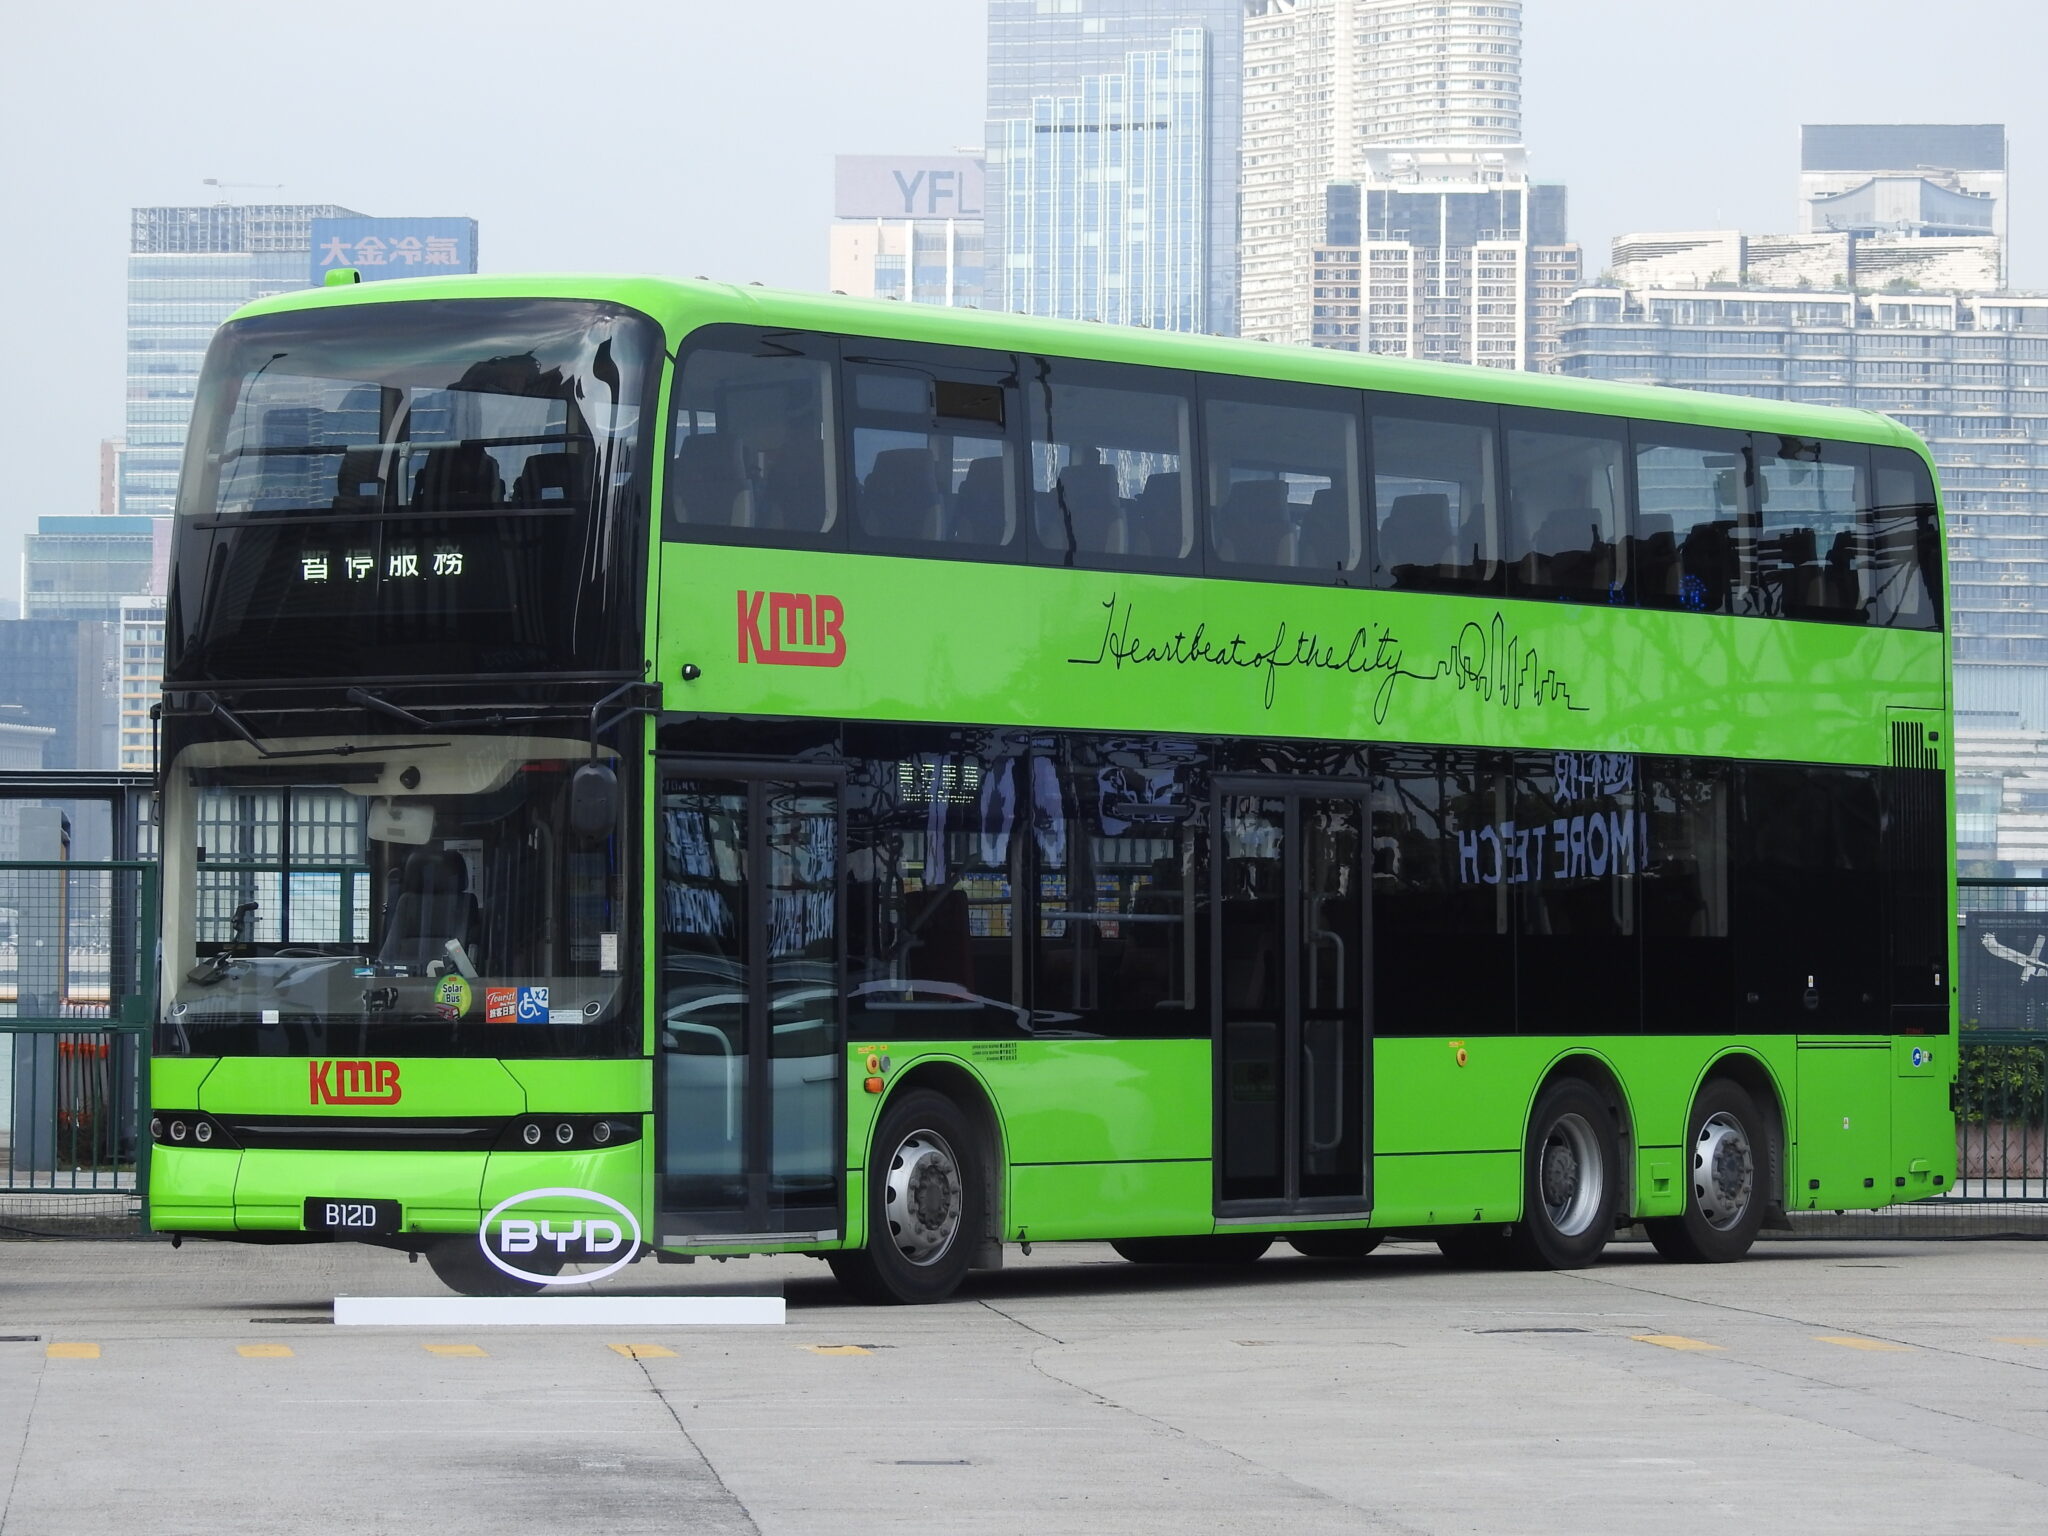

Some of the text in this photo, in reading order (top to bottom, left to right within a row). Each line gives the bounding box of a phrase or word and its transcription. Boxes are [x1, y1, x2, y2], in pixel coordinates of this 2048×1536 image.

[319, 235, 461, 266] 大金冷氣
[1091, 591, 1403, 725] Heartbeat of the City
[442, 983, 463, 993] Solar
[534, 990, 548, 1001] x2
[446, 993, 460, 1003] Bus
[487, 991, 516, 1005] Tourist
[325, 1203, 377, 1227] B12D
[501, 1219, 622, 1253] BYD
